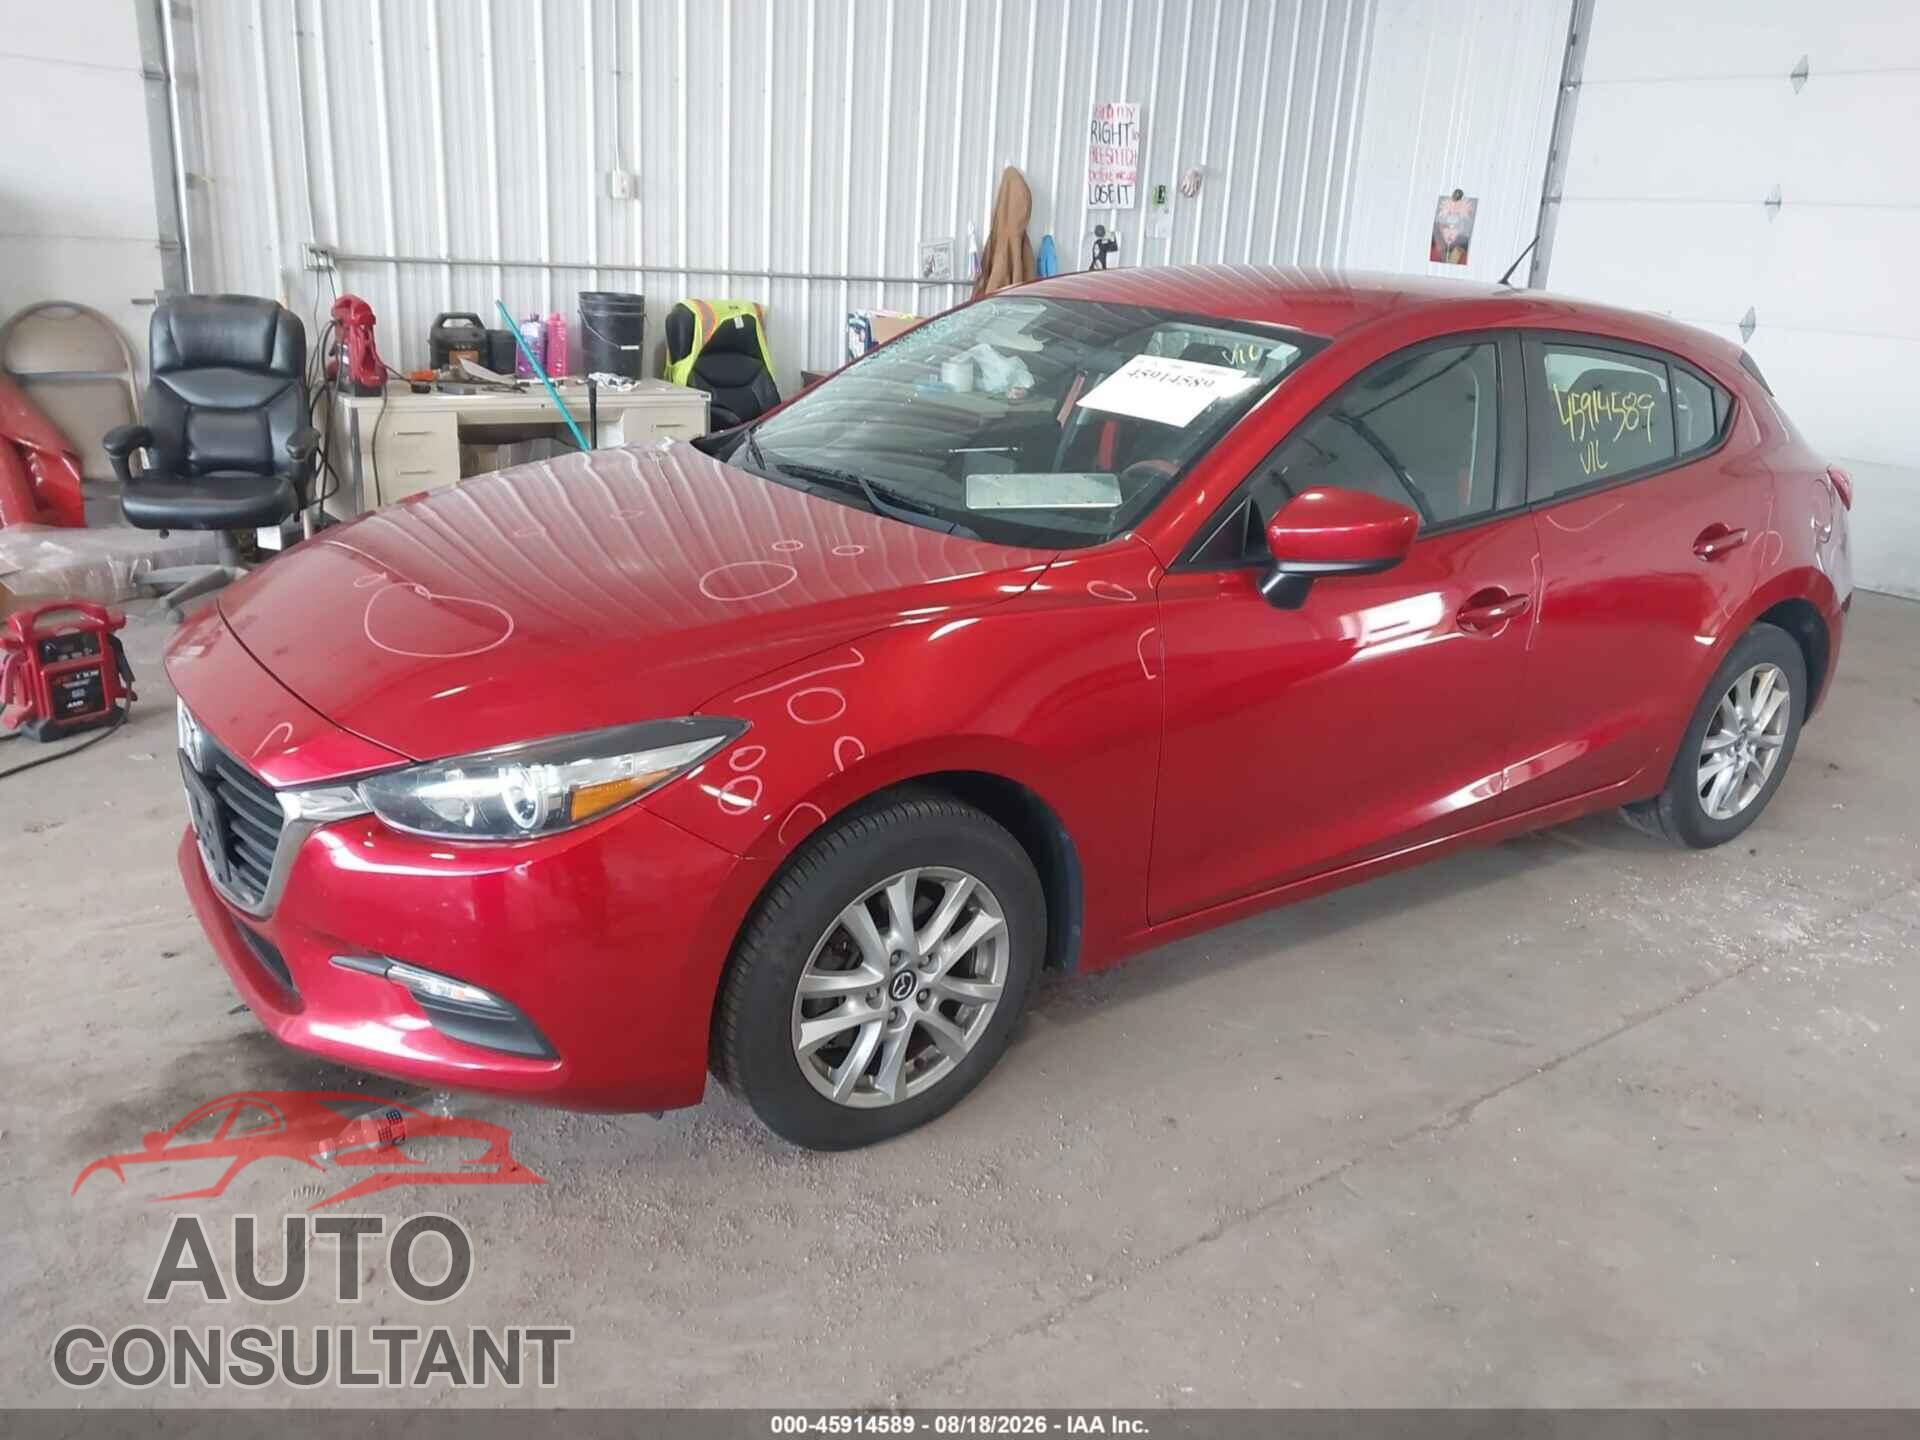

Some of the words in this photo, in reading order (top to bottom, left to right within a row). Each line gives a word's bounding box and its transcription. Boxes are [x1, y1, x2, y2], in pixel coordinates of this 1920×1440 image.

[1090, 119, 1135, 147] RIGHT
[1088, 183, 1114, 205] LOSE
[1117, 183, 1133, 205] IT
[1552, 383, 1655, 442] 45914589
